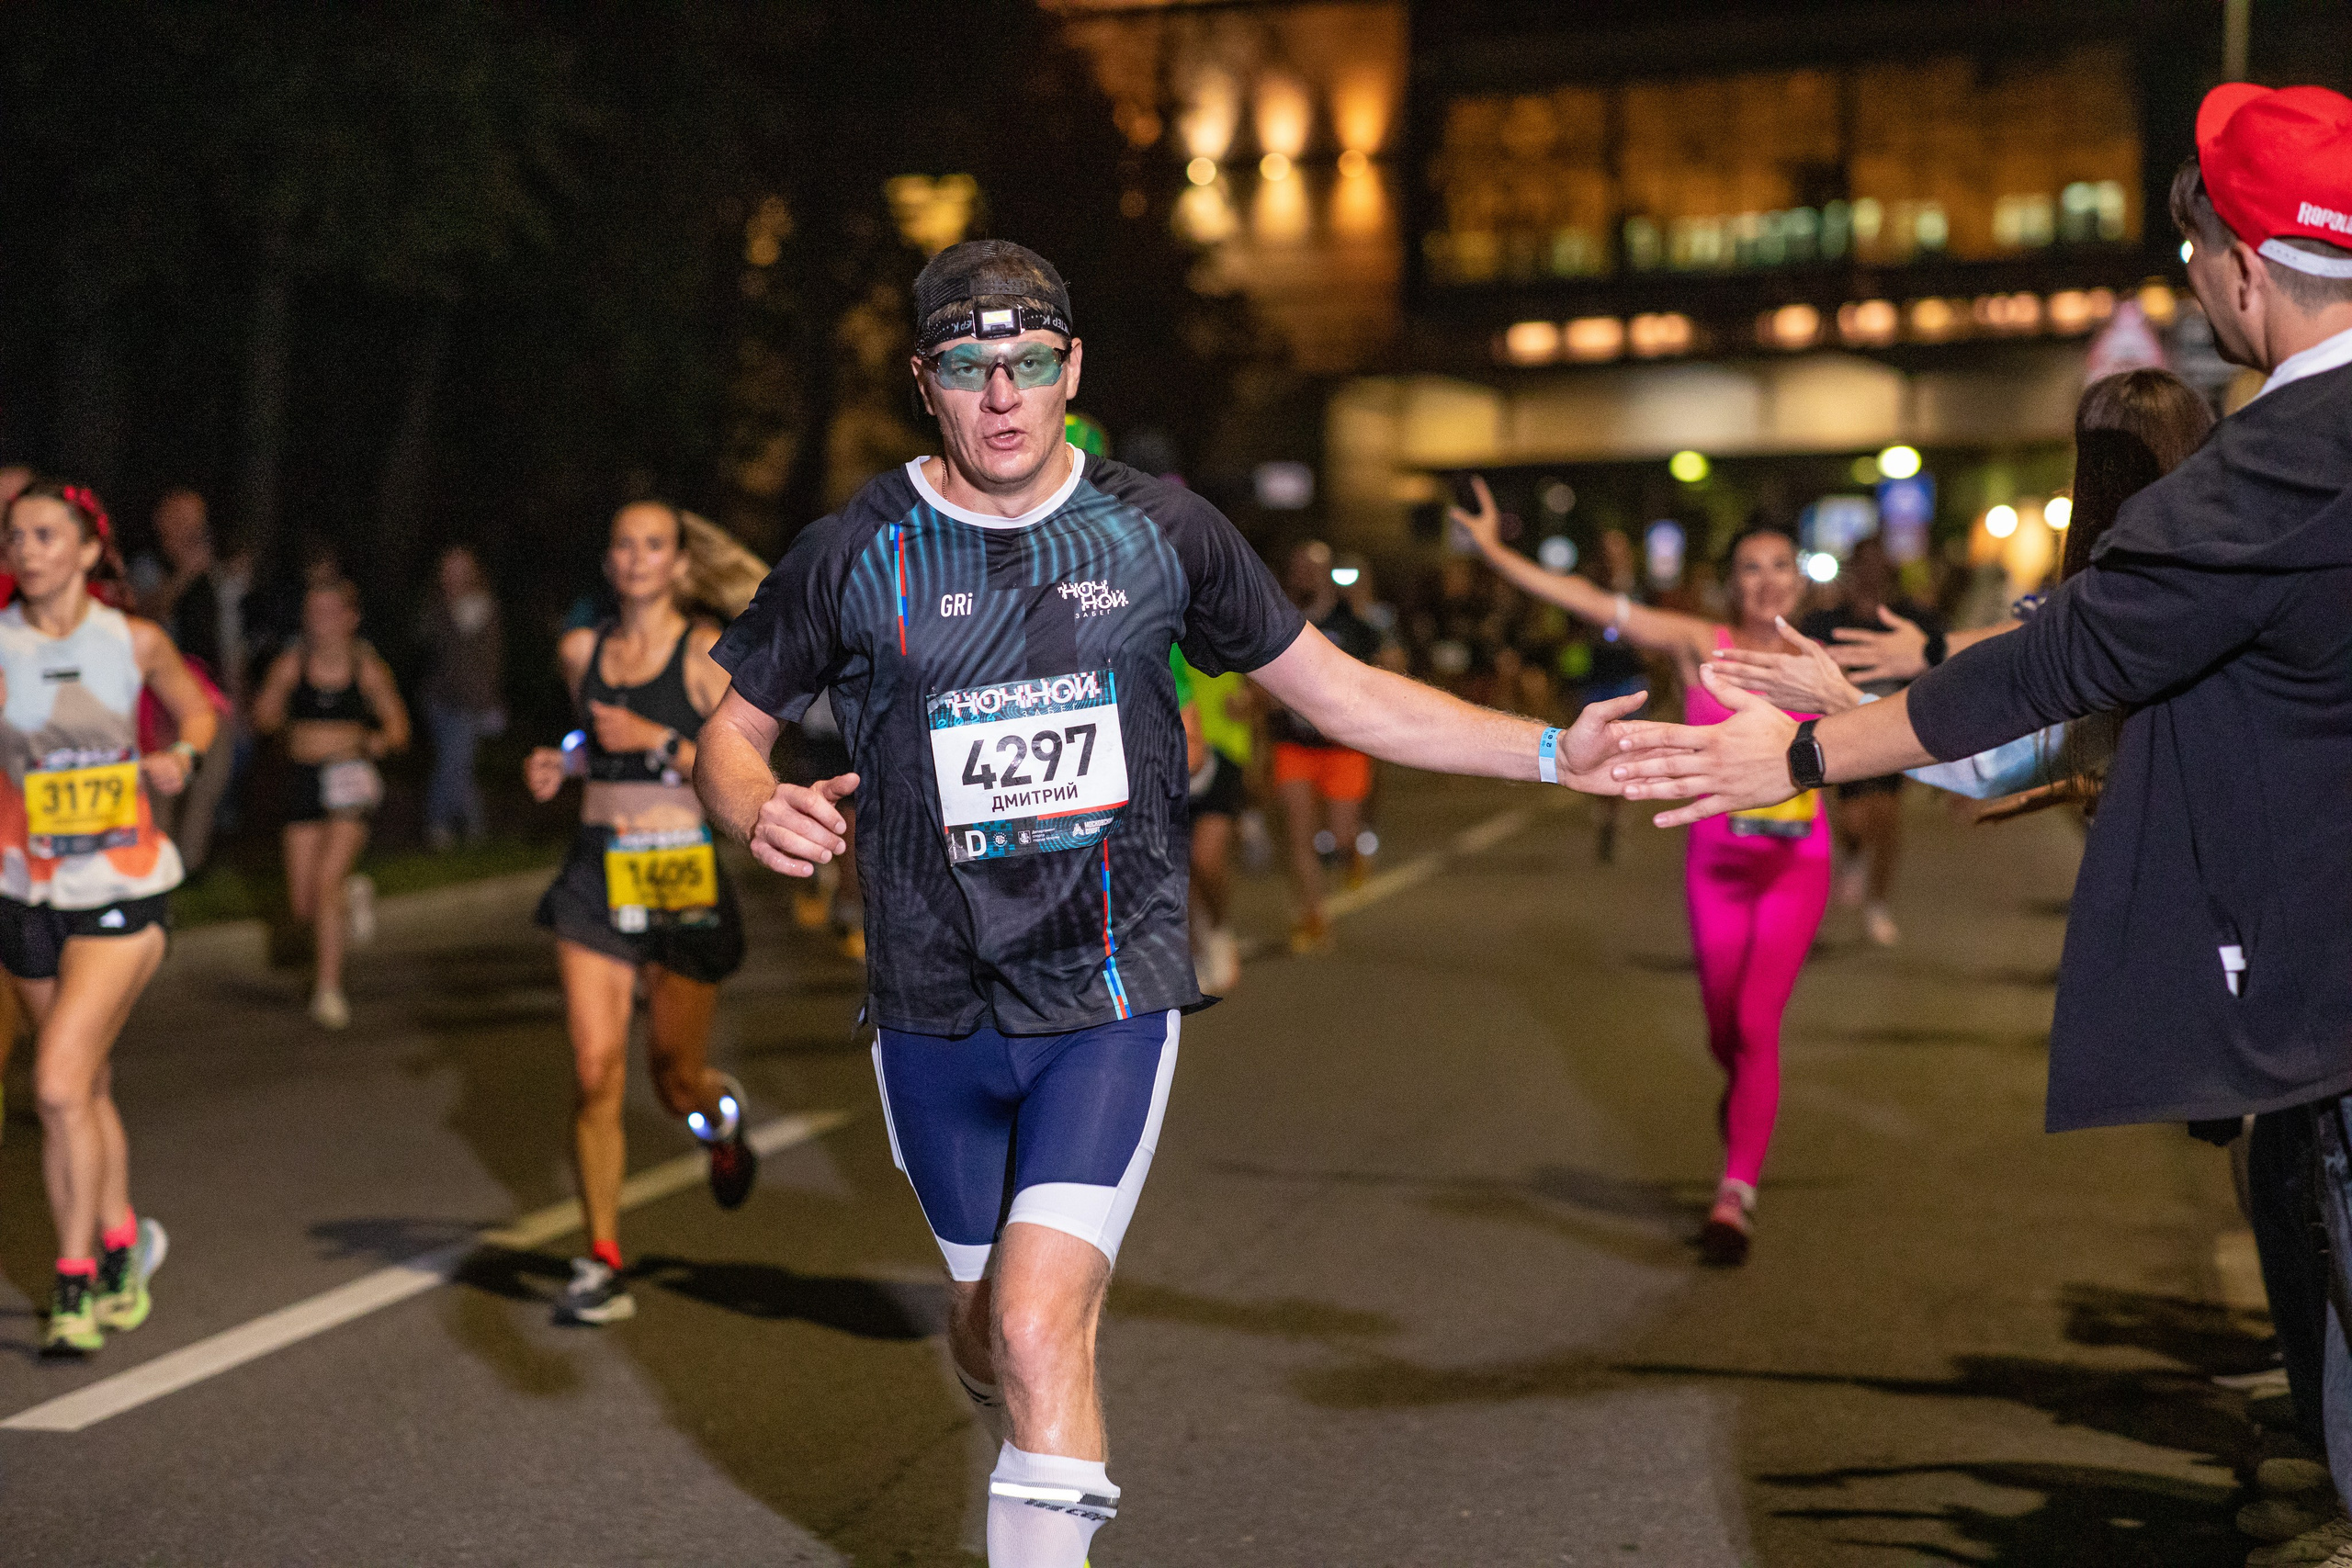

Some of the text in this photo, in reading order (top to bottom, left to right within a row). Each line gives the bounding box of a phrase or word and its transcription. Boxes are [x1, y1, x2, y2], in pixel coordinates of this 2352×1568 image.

[941, 592, 973, 617] GRi
[1075, 609, 1111, 618] ЗАБЕГ
[1022, 703, 1078, 718] ЗАБЕГ
[961, 723, 1097, 790] 4297
[42, 775, 125, 815] 3179
[991, 782, 1079, 813] ДМИТРИЙ
[965, 829, 987, 858] D
